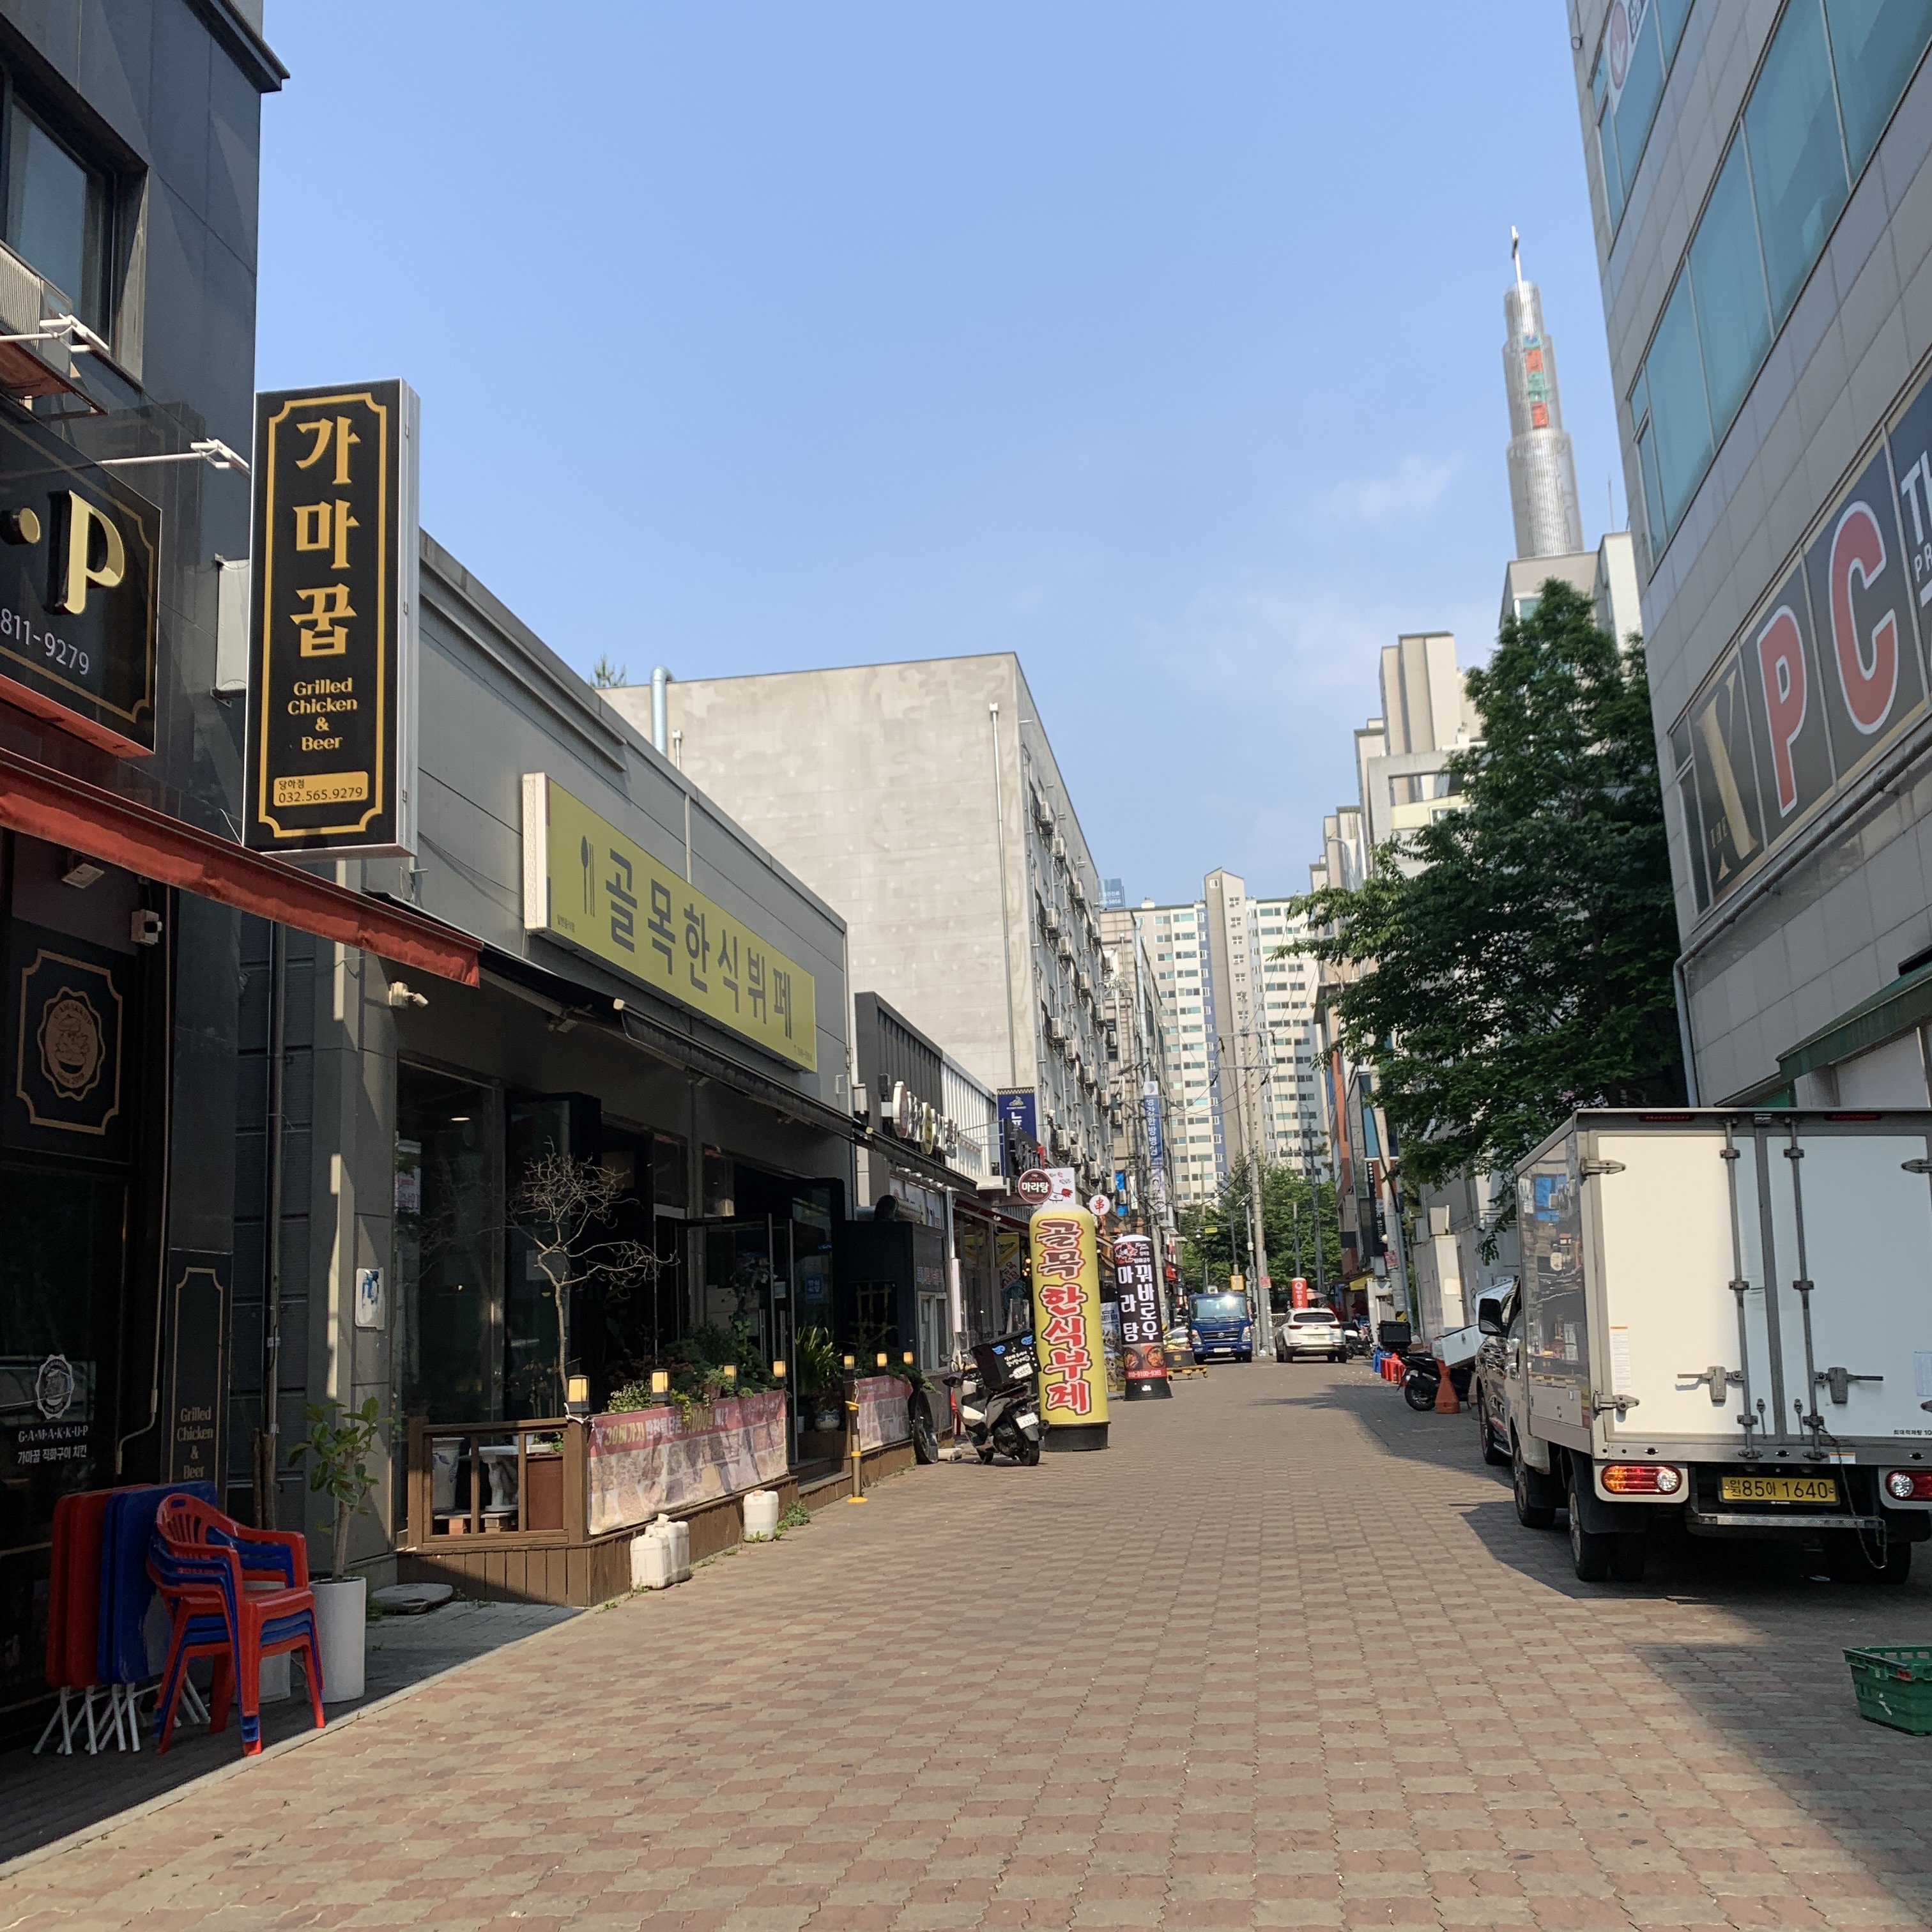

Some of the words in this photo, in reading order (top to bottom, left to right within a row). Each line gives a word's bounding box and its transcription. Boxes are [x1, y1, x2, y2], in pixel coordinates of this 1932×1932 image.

[290, 416, 361, 659] 가마꿉
[1, 608, 89, 675] 811-9279
[293, 677, 353, 696] Grilled
[288, 697, 358, 716] Chicken
[315, 716, 329, 732] &
[302, 737, 343, 751] Beer
[279, 779, 305, 790] 당하점
[279, 787, 362, 803] 032.565.9279
[606, 848, 792, 1039] 골목한식뷔페
[1022, 1182, 1049, 1193] 마라탕
[1094, 1197, 1105, 1214] 串
[1036, 1219, 1085, 1280] 골목
[1117, 1266, 1139, 1341] 마라탕
[1135, 1264, 1159, 1340] 꿔바로우
[1039, 1284, 1092, 1415] 한식부페
[181, 1406, 211, 1422] Grilled
[177, 1425, 213, 1442] Chicken
[73, 1444, 88, 1459] 치킨
[190, 1445, 199, 1459] &
[183, 1465, 204, 1480] Beer
[1729, 1479, 1741, 1497] 인천
[1782, 1481, 1828, 1499] 1640
